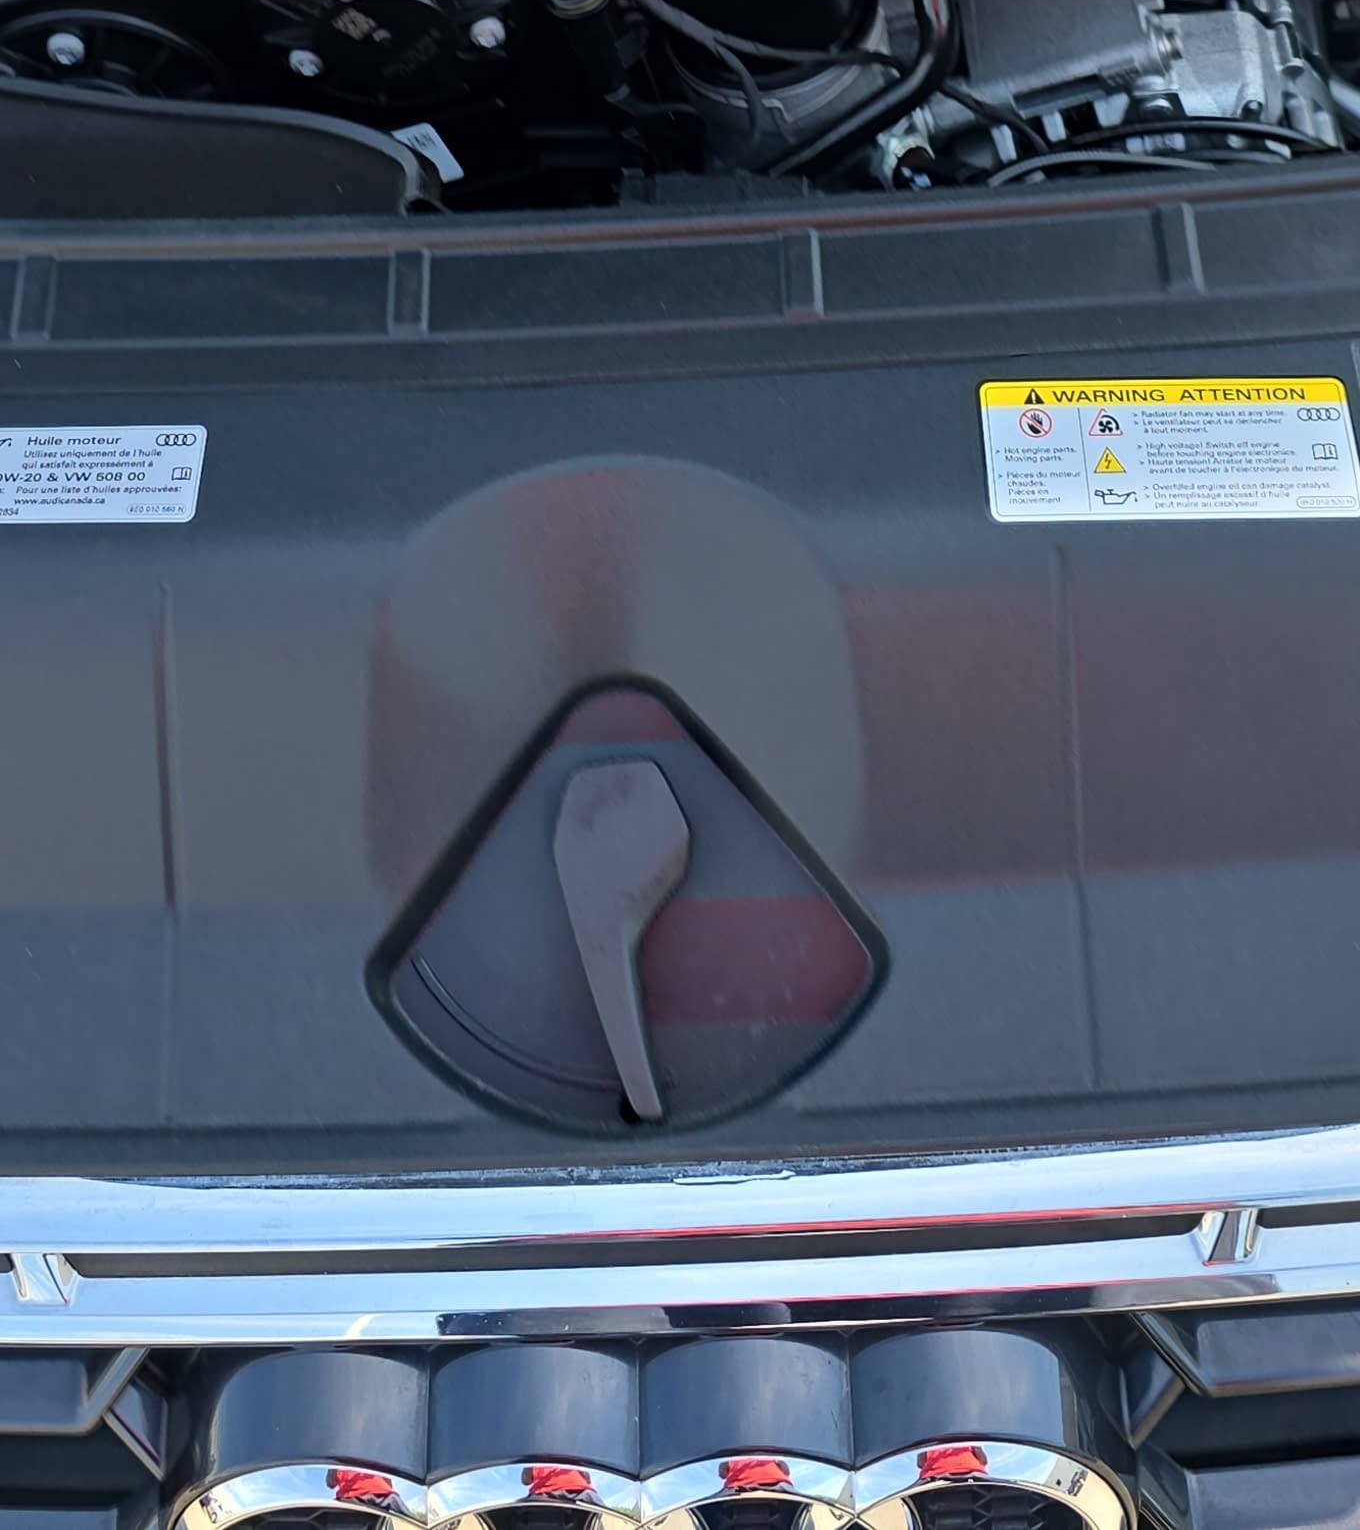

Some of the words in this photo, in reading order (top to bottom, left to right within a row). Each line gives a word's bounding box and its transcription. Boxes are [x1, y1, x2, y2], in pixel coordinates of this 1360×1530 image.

[1053, 390, 1165, 402] WARNING
[1180, 388, 1306, 401] ATTENTION
[1141, 410, 1177, 418] Radiator
[1248, 410, 1263, 418] any
[27, 436, 62, 446] Huile
[67, 436, 121, 446] moteur
[1145, 442, 1166, 451] High
[1206, 441, 1235, 449] Switch
[24, 450, 57, 458] Utilisez
[60, 450, 116, 459] uniquement
[119, 449, 130, 457] de
[133, 449, 162, 457] l'huile
[1022, 447, 1051, 455] engine
[1177, 449, 1215, 457] touching
[22, 461, 37, 470] qui
[40, 460, 76, 469] satisfait
[79, 460, 145, 469] expressément
[47, 473, 58, 482] &
[65, 473, 92, 482] VW
[95, 472, 123, 482] 508
[127, 472, 146, 481] 00
[16, 486, 38, 494] Pour
[1153, 483, 1195, 491] Overfilled
[1197, 483, 1227, 491] engine
[1259, 482, 1294, 490] damage
[1169, 492, 1222, 500] remplissage
[1224, 491, 1260, 499] excessif
[14, 497, 105, 505] www.audicanada.ca
[1155, 501, 1173, 509] peut
